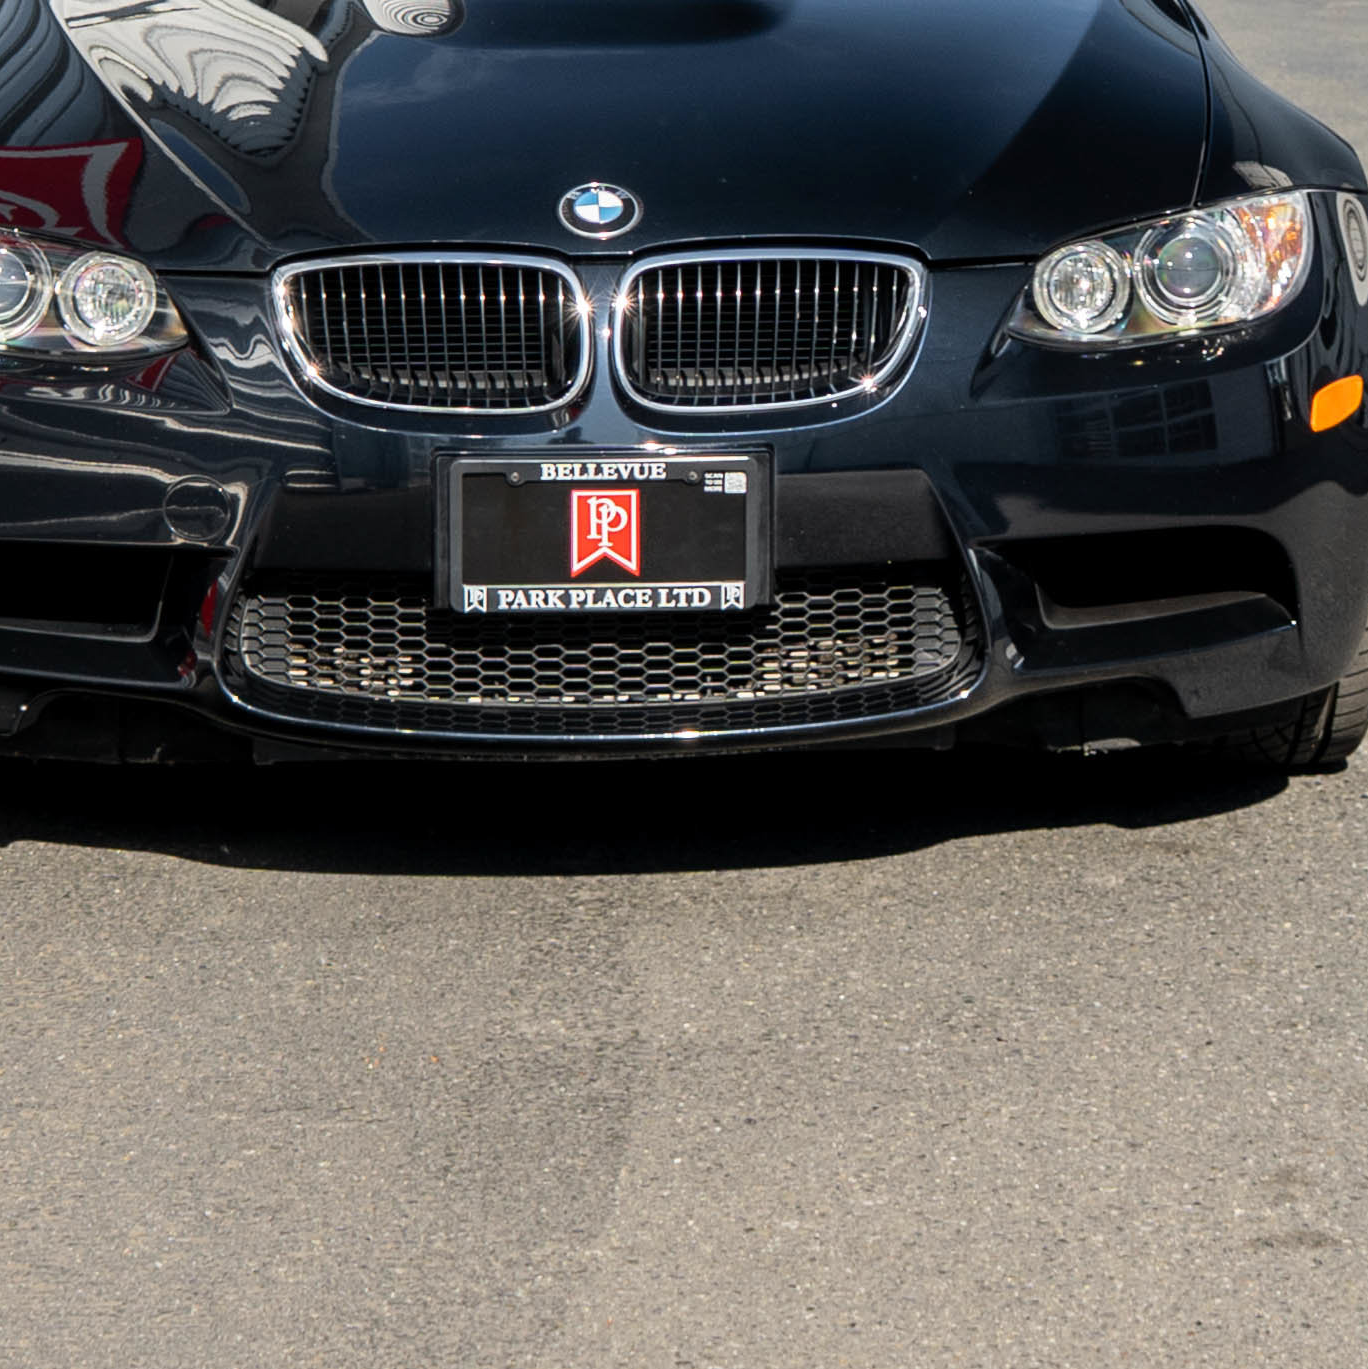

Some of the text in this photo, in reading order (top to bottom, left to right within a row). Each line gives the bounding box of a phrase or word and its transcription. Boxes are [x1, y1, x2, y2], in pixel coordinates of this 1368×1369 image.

[540, 463, 667, 481] BELLEVUE
[497, 589, 566, 609] PARK
[569, 588, 653, 609] PLACE
[657, 587, 711, 608] LTD
